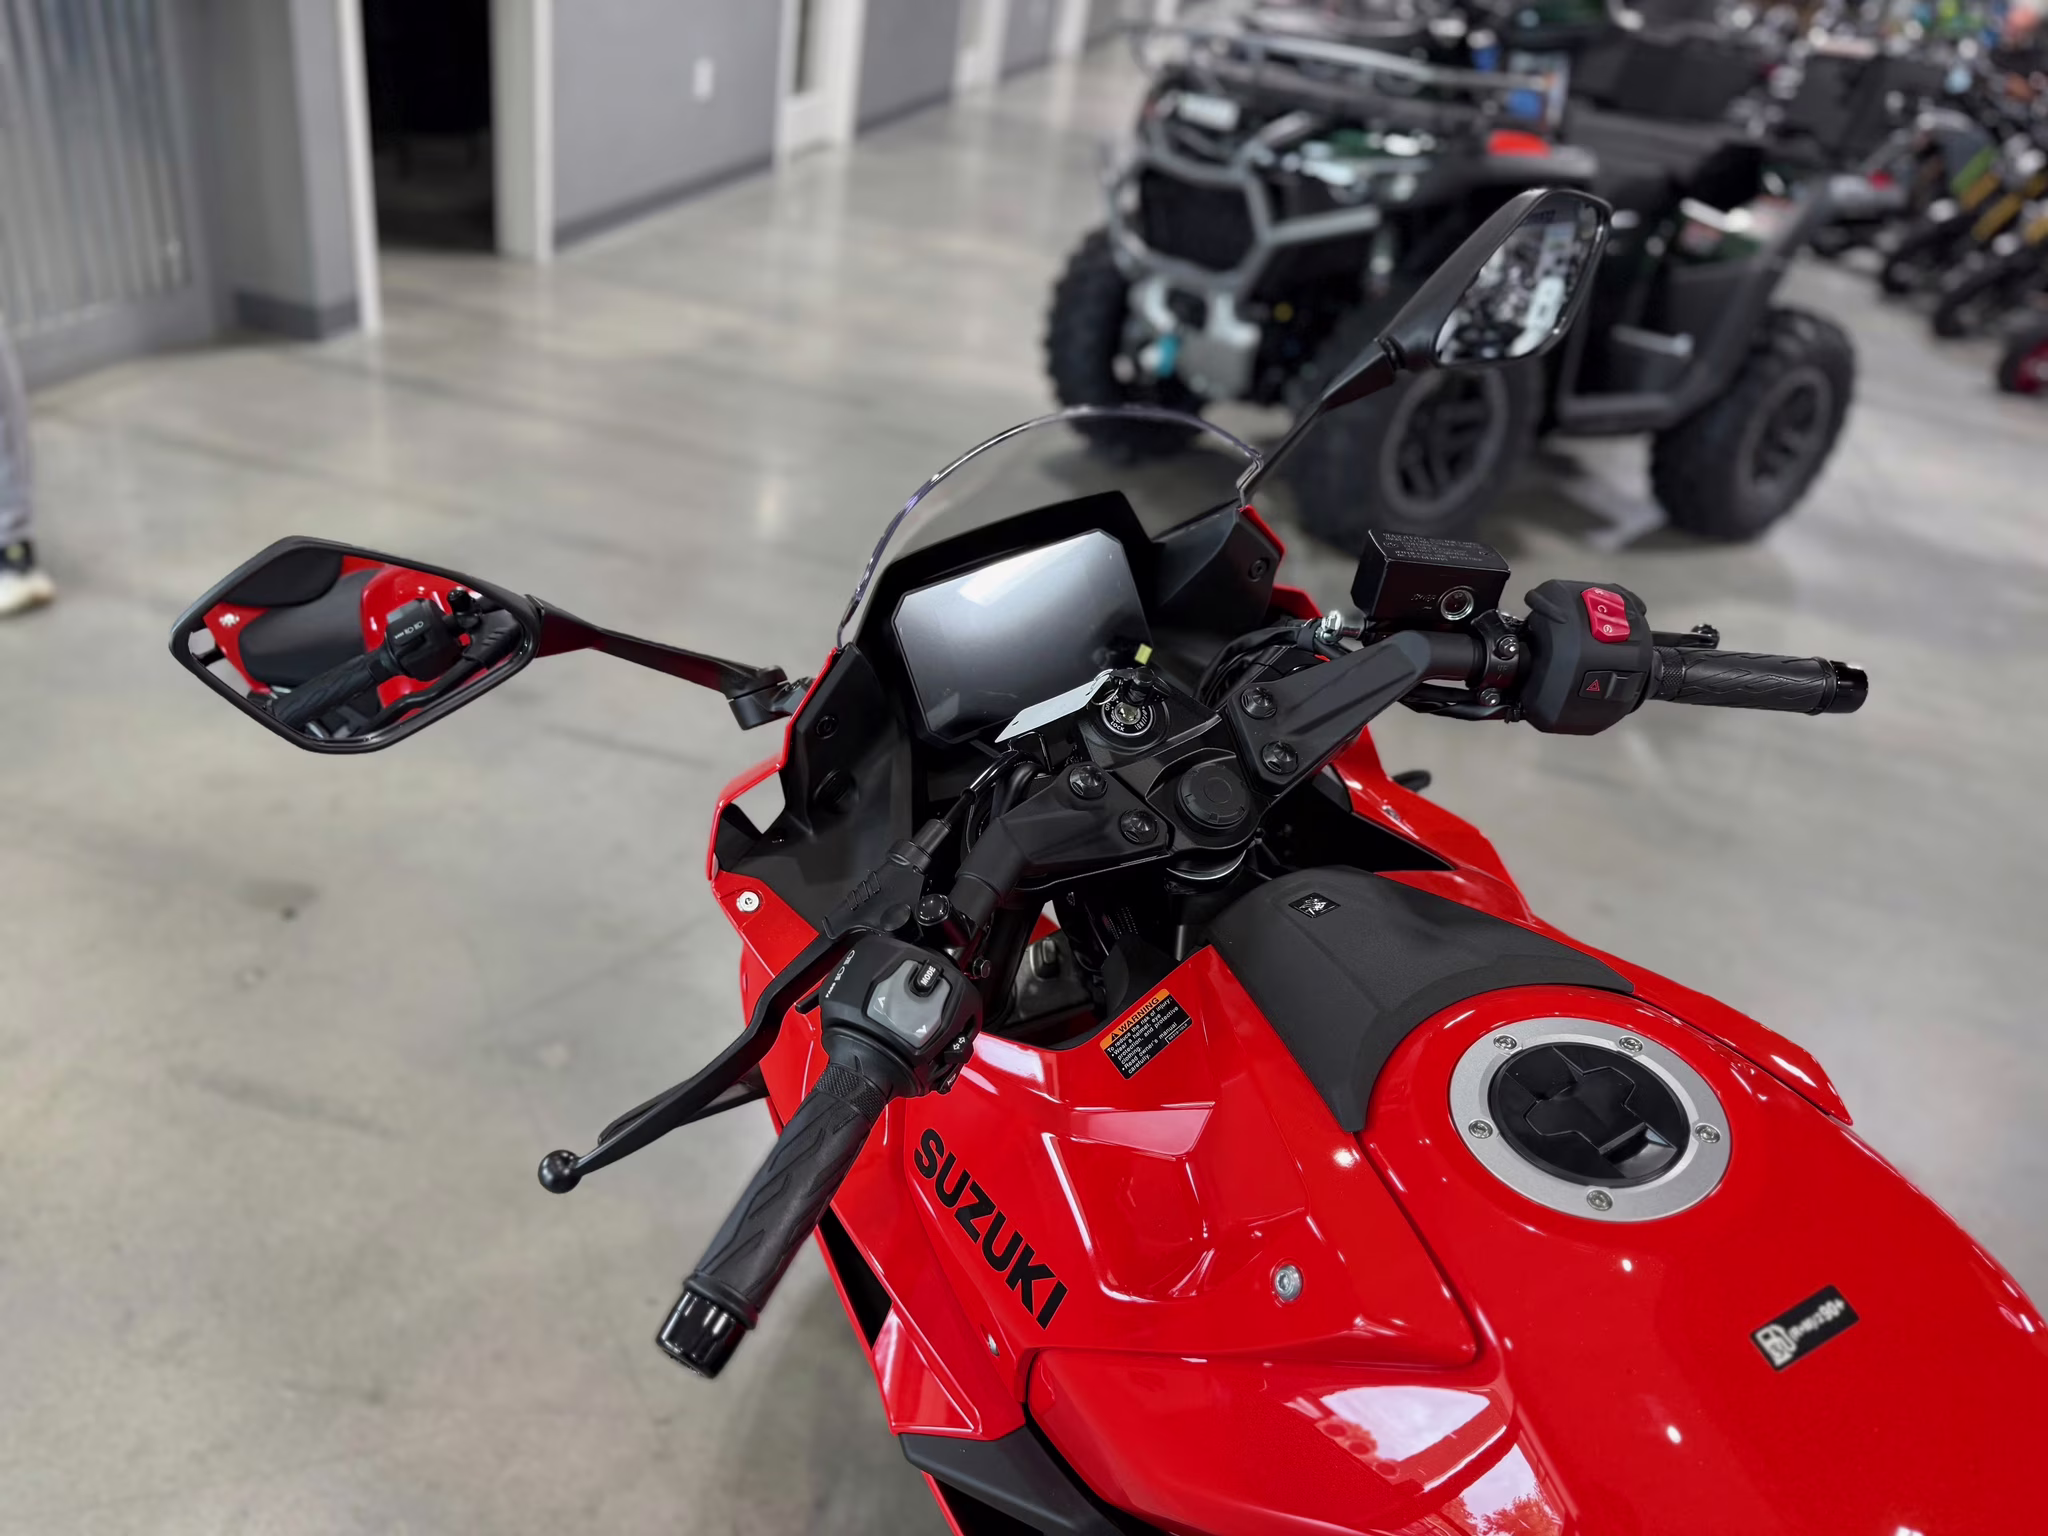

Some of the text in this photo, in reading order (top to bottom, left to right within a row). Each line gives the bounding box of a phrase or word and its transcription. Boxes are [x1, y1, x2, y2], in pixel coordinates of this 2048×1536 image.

[1110, 720, 1125, 732] LOCK
[920, 965, 936, 986] MODE
[1113, 1030, 1131, 1047] reduce
[1130, 1022, 1139, 1032] the
[1139, 1014, 1149, 1024] risk
[1155, 995, 1173, 1012] injury:
[1113, 1042, 1127, 1055] Wear
[1132, 1021, 1151, 1039] helmet,
[1151, 1013, 1161, 1023] eye
[1117, 1036, 1144, 1061] protection,
[1143, 1026, 1154, 1037] and
[1154, 1005, 1179, 1028] protective
[1118, 996, 1159, 1033] WARNING
[1120, 1044, 1142, 1065] clothing.
[1124, 1055, 1138, 1069] Read
[1138, 1038, 1158, 1057] owner's
[1158, 1021, 1177, 1039] manual
[1127, 1052, 1151, 1074] carefully.
[914, 1128, 1069, 1331] SUZUKI
